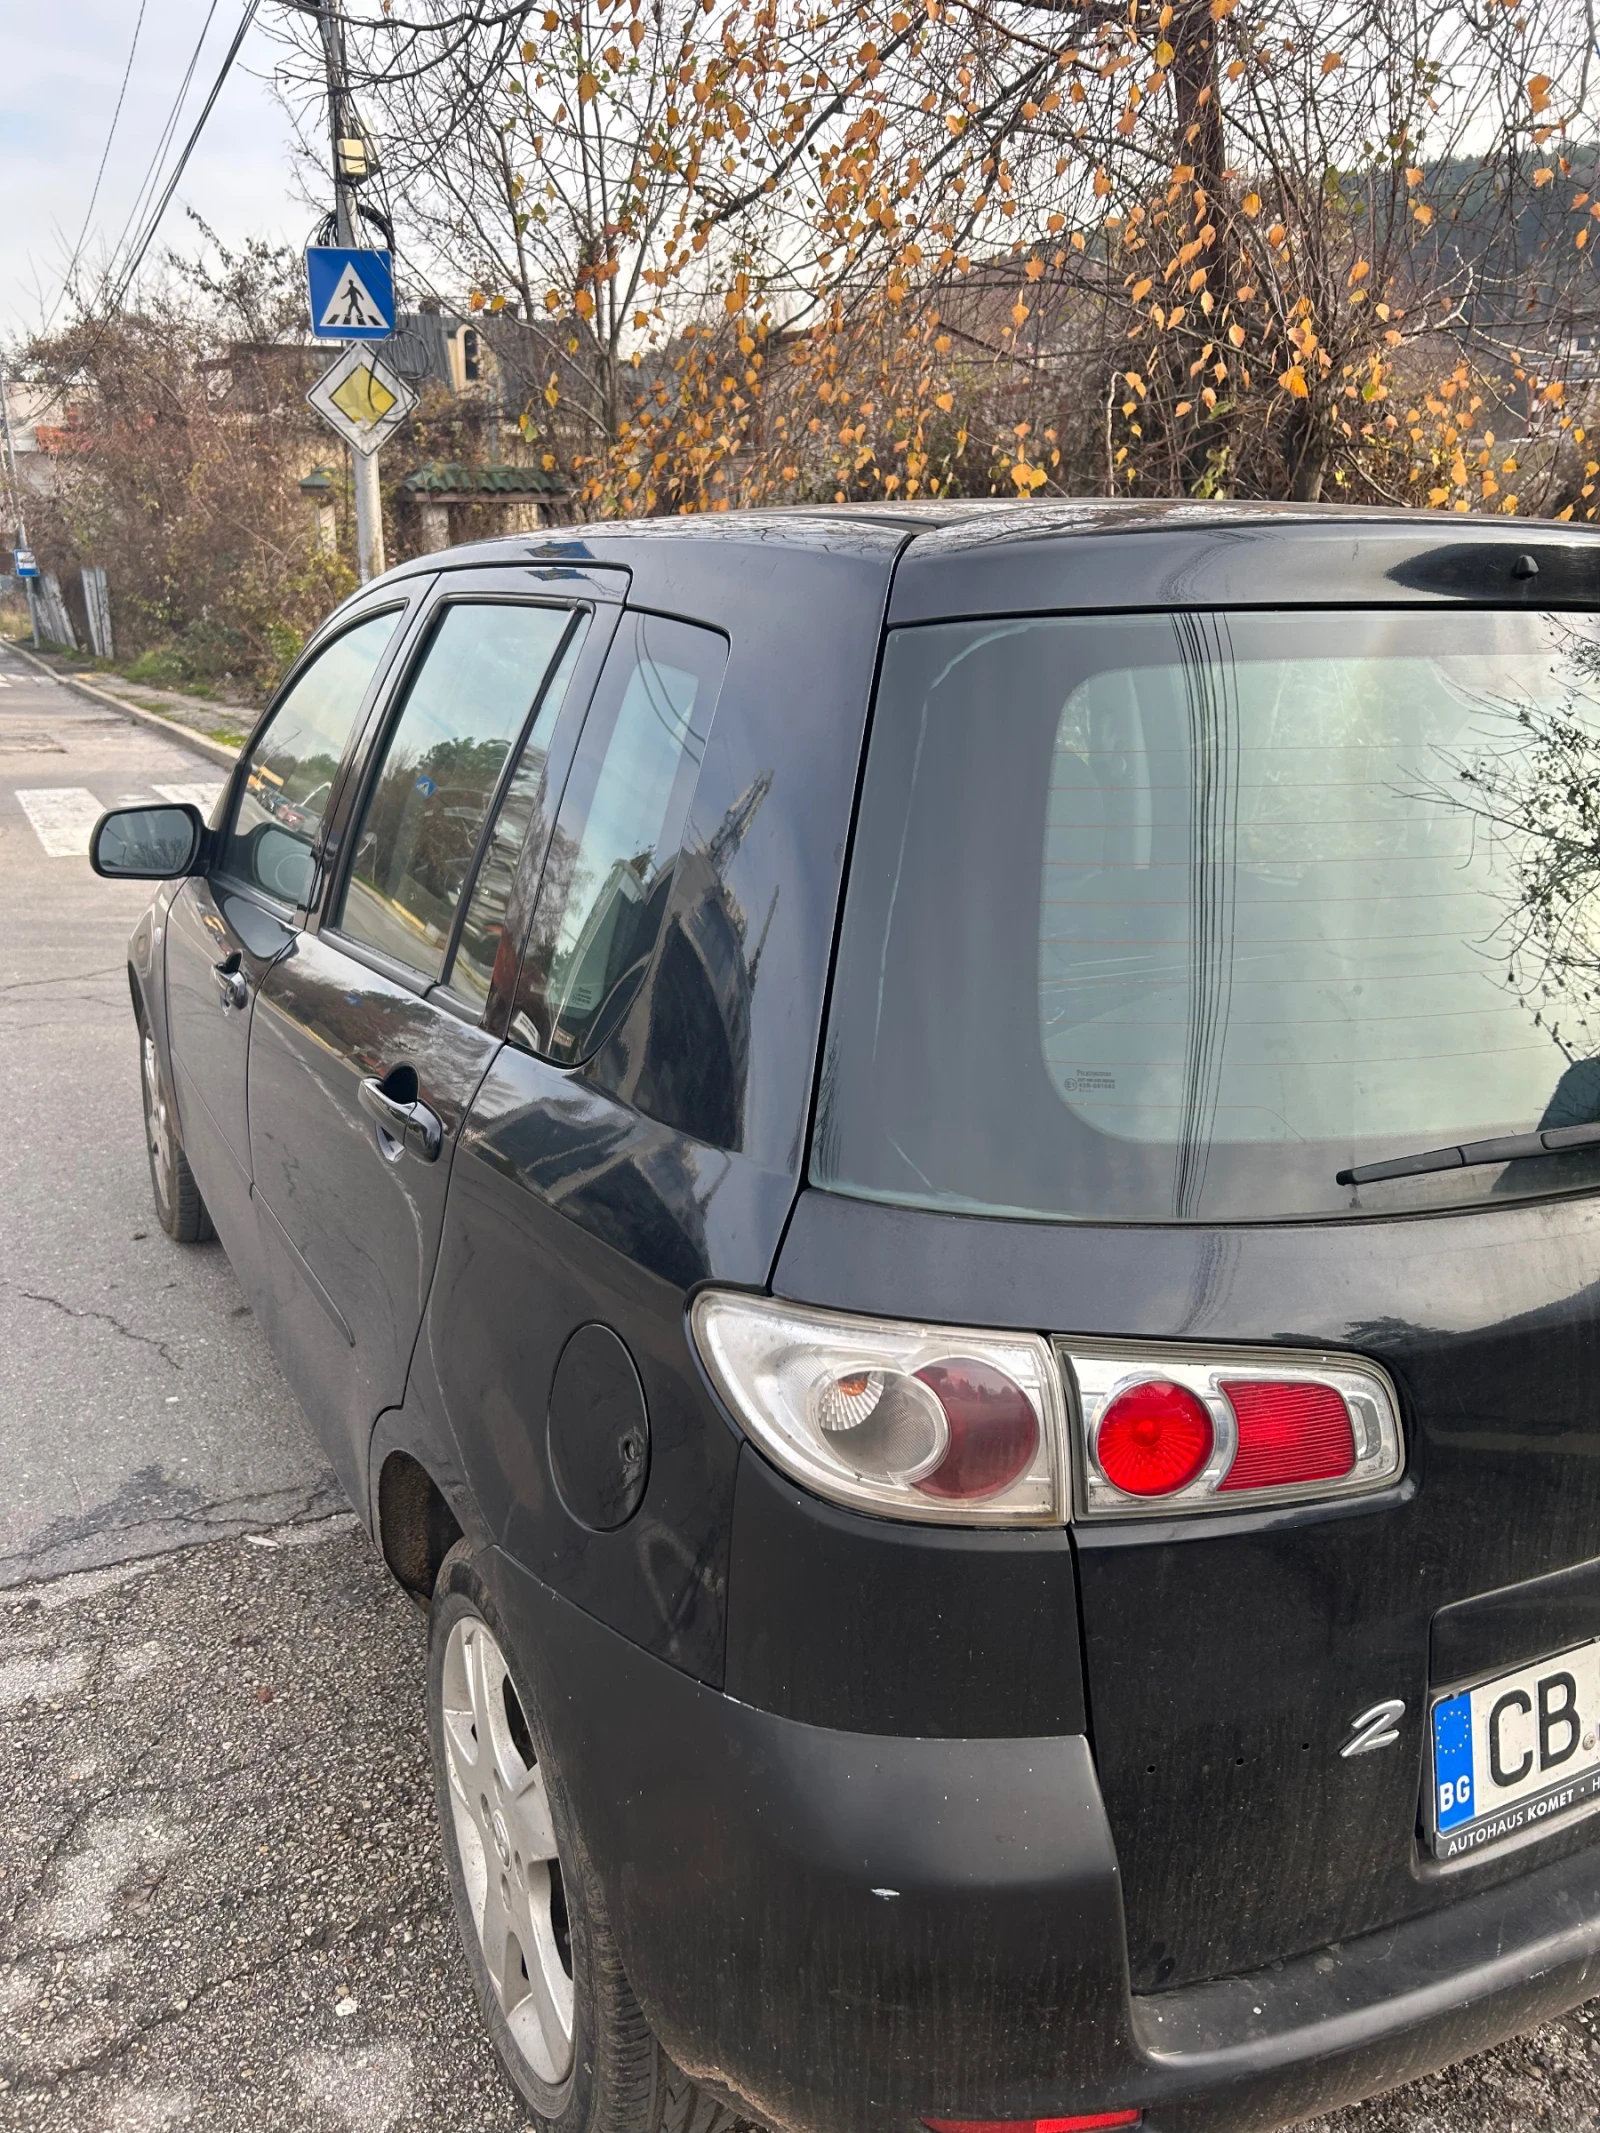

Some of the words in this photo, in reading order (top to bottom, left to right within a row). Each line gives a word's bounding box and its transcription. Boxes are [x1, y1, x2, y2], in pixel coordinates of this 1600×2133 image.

[1341, 1699, 1406, 1757] 2
[1439, 1775, 1471, 1813] BG
[1447, 1811, 1524, 1857] AUTOHAUS
[1527, 1788, 1575, 1822] KOMET
